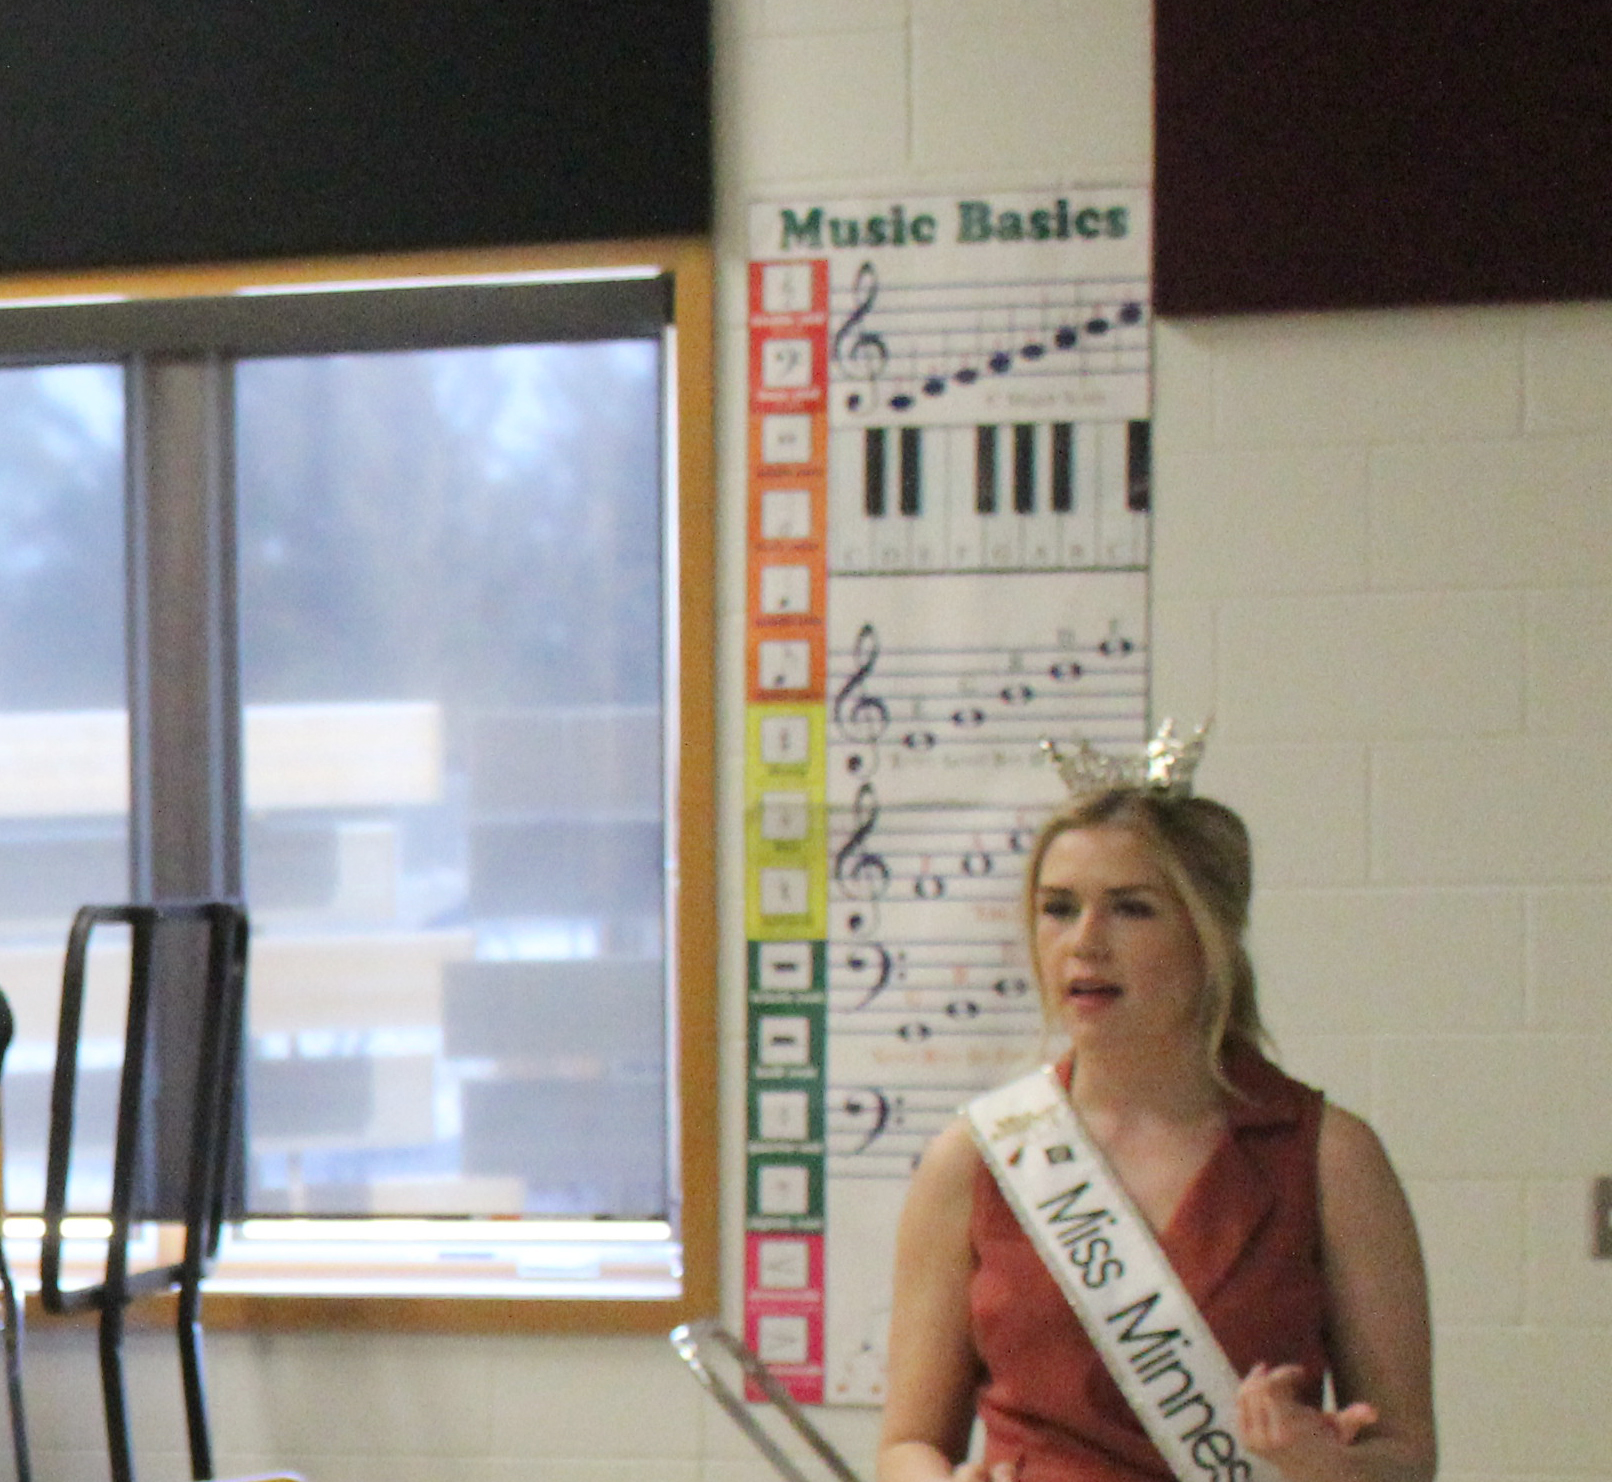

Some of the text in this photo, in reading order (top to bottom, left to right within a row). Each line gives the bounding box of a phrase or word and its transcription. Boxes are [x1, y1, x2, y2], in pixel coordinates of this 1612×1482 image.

[779, 200, 1131, 250] Music Basics
[1037, 1180, 1127, 1290] Miss
